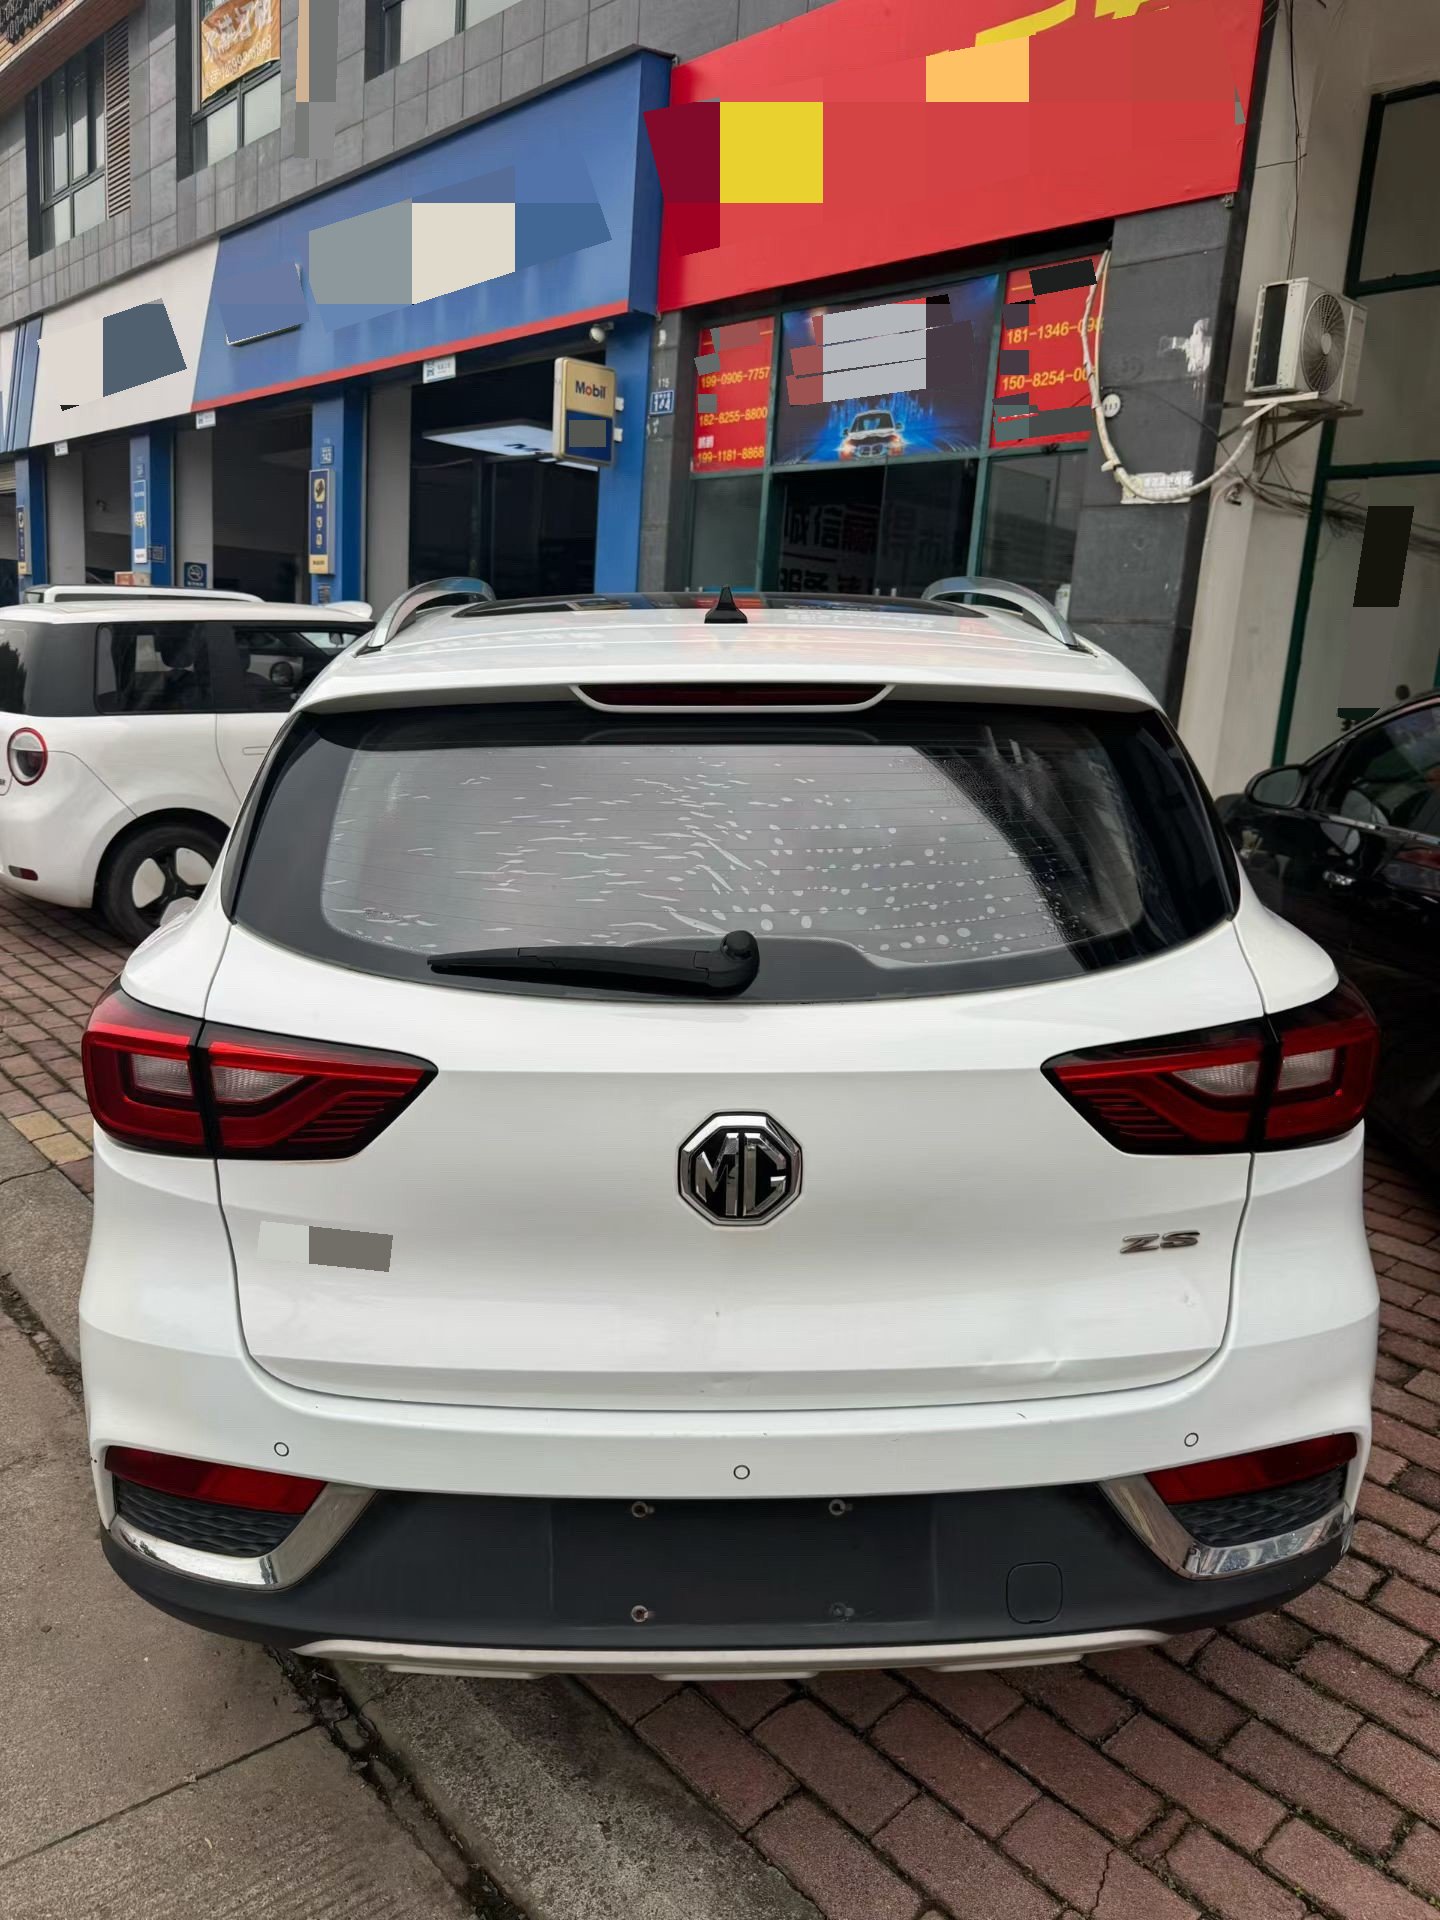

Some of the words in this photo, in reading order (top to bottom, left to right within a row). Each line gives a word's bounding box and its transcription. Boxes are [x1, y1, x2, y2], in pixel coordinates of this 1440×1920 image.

[702, 366, 771, 388] 199-0906-7757
[575, 380, 606, 399] Mobil
[699, 406, 769, 427] 182-8255-8800
[695, 1132, 787, 1216] MG
[1120, 1231, 1200, 1254] ZS
